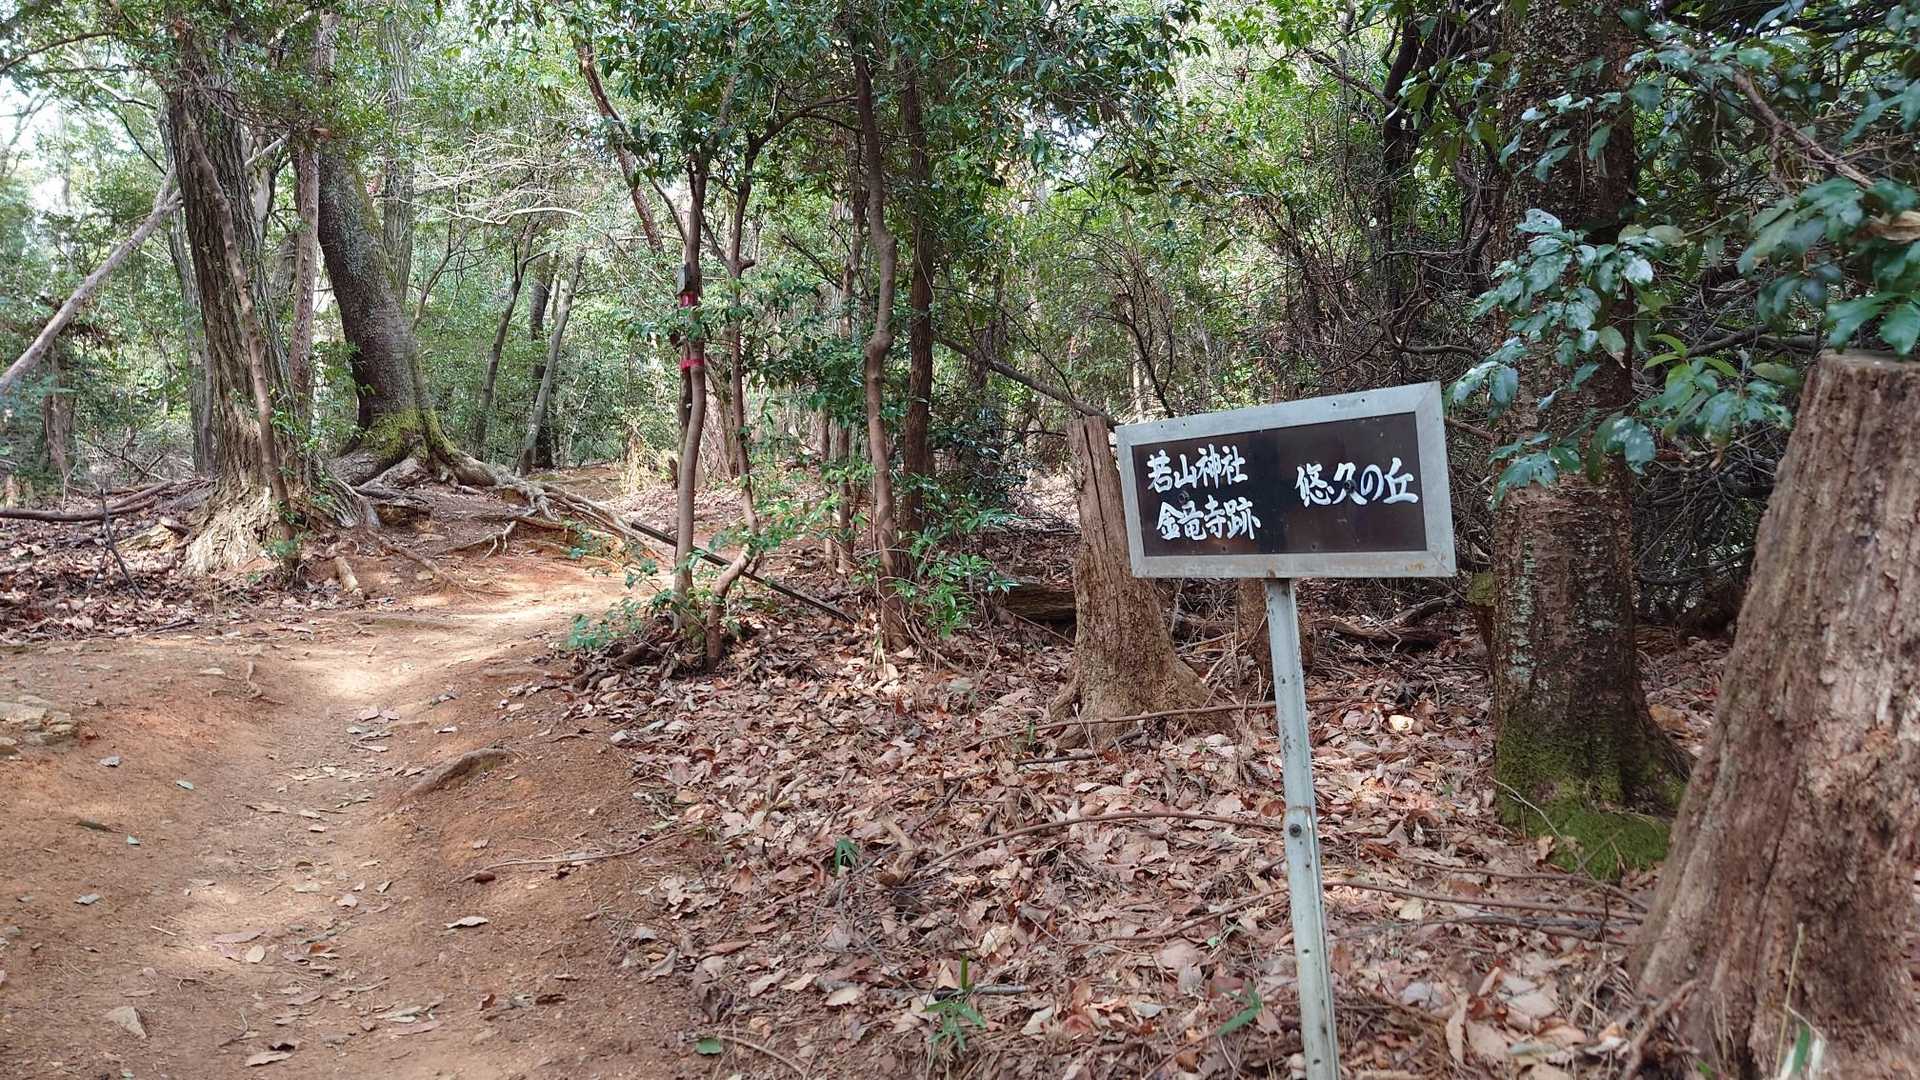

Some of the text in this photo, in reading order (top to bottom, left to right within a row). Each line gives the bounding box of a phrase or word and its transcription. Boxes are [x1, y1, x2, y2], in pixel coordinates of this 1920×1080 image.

[1147, 444, 1248, 493] 若山神社
[1295, 457, 1419, 508] 悠久の丘
[1157, 494, 1262, 541] 金竜寺跡
